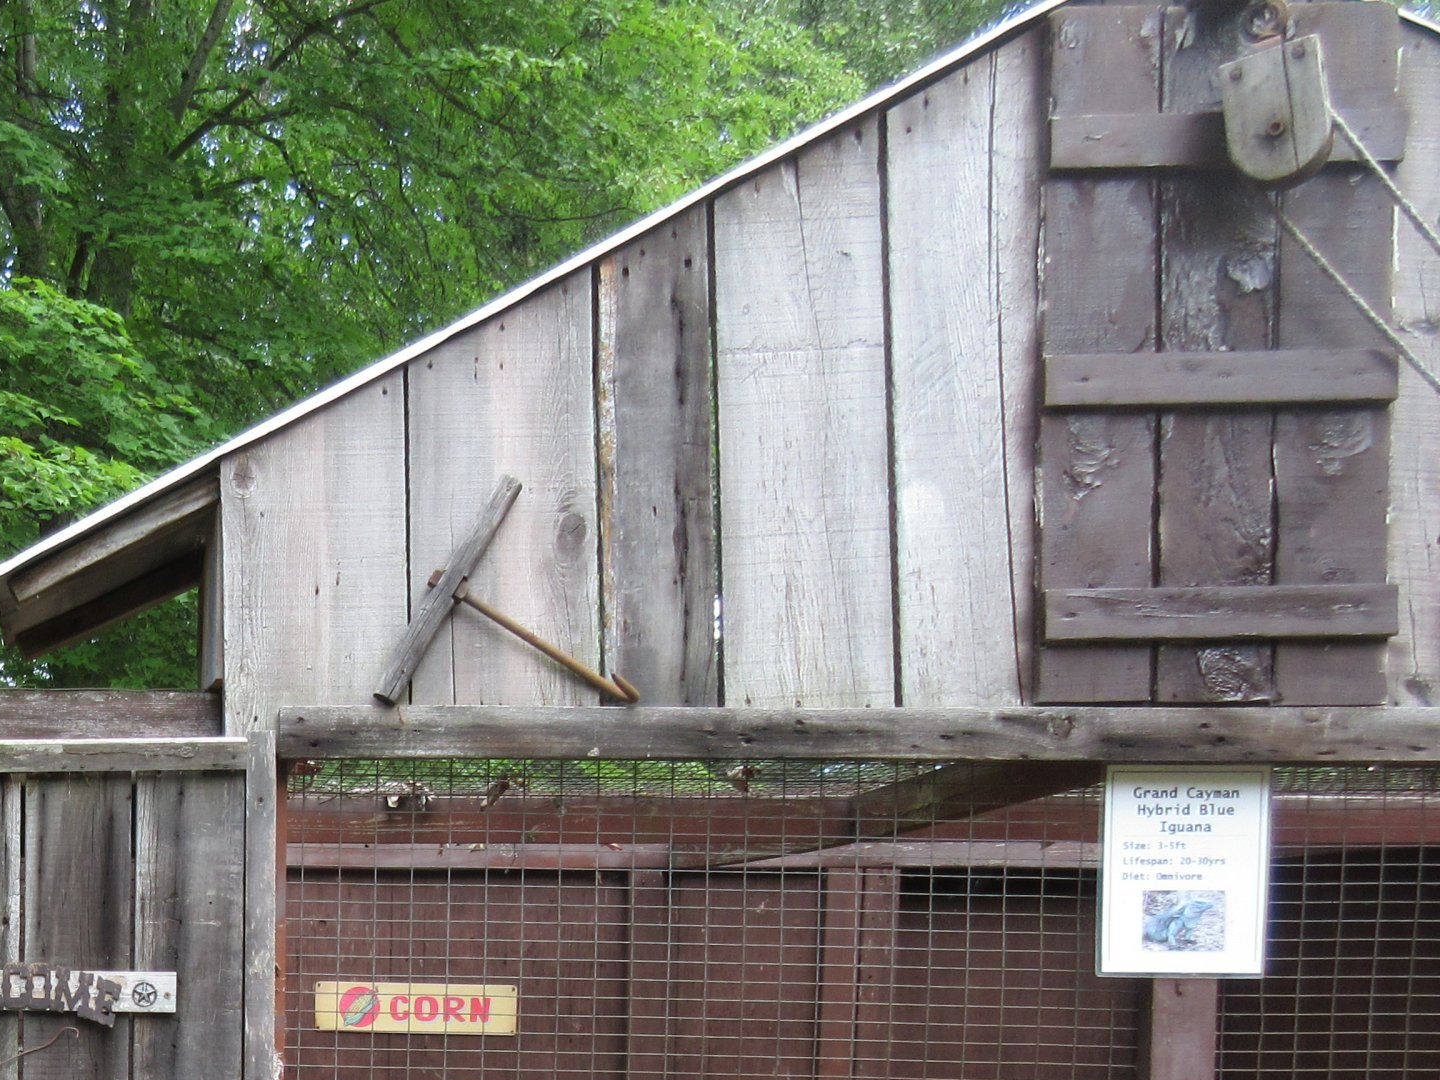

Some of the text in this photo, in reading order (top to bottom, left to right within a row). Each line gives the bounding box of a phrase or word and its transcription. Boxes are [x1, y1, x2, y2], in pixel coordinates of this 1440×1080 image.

[1133, 786, 1240, 802] Grand Cayman
[1137, 803, 1235, 818] Hybrid Blue
[1159, 820, 1212, 835] Iguana
[1122, 841, 1151, 850] Size:
[1122, 856, 1226, 867] Lifespan: 20-30yrs
[1122, 872, 1203, 881] Diet: Omnivore
[389, 995, 491, 1023] CORN
